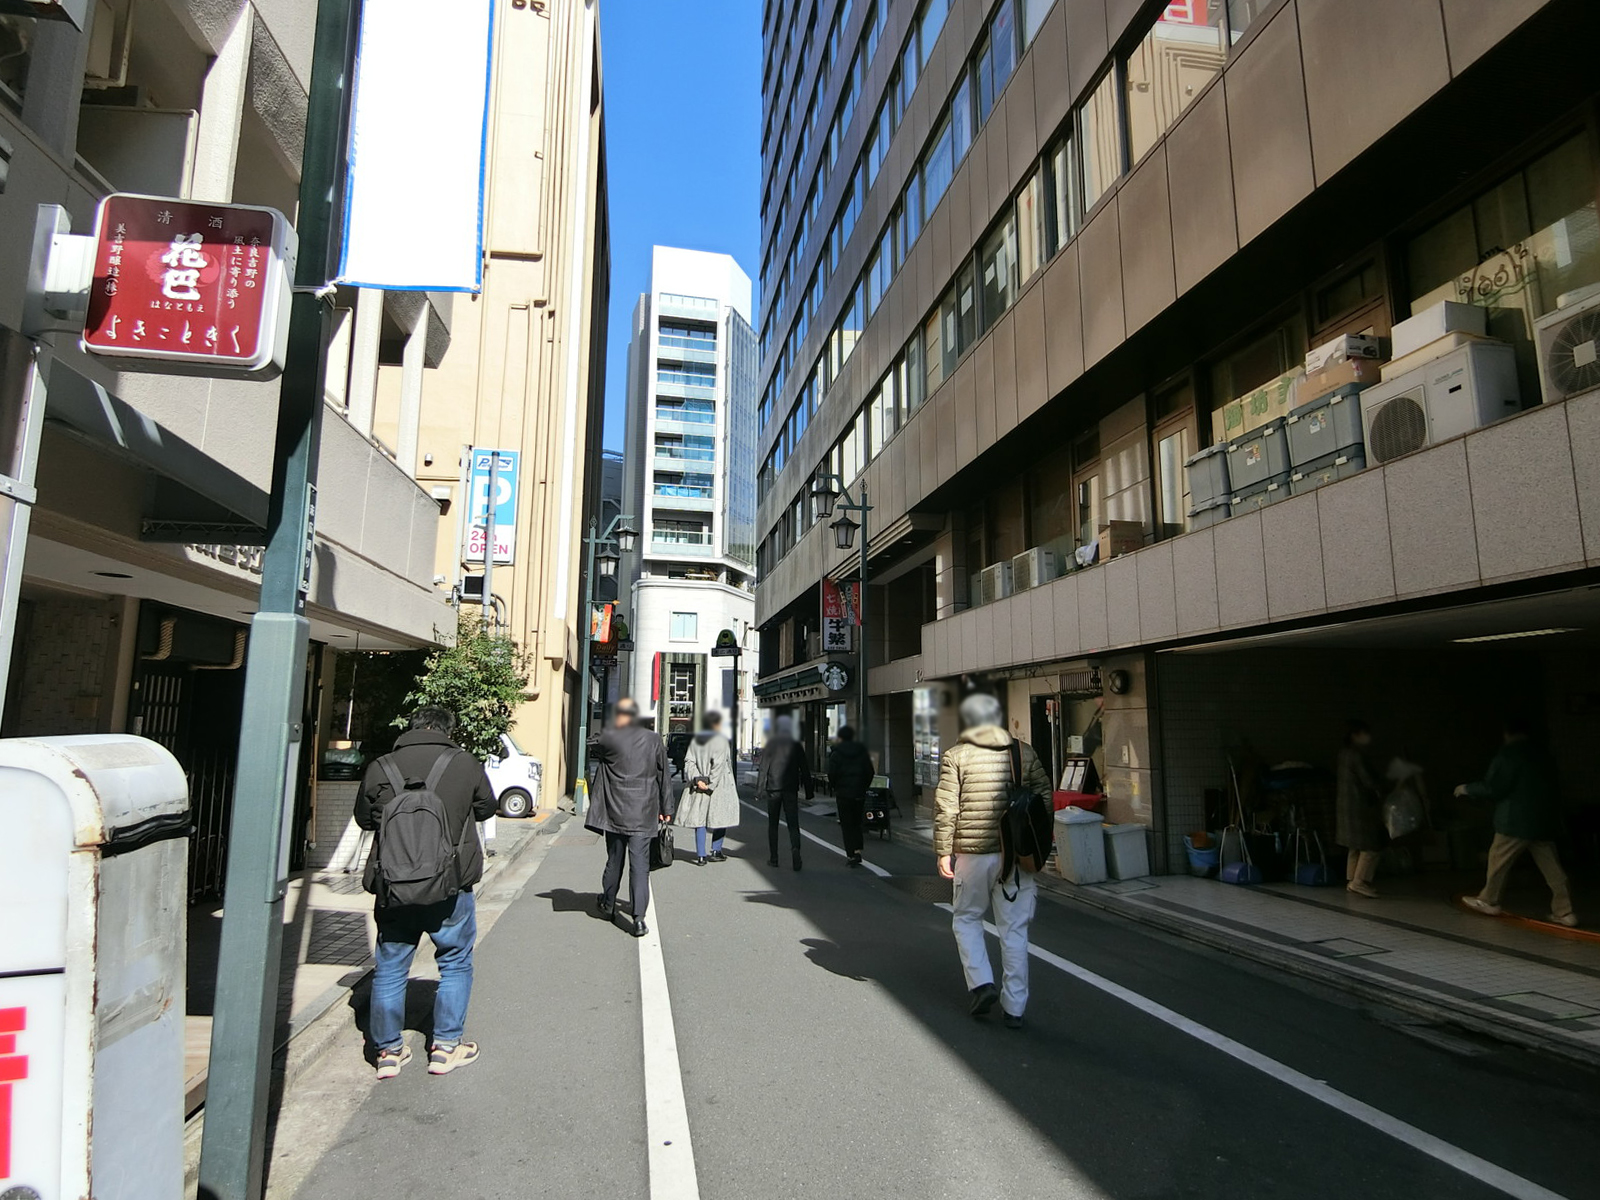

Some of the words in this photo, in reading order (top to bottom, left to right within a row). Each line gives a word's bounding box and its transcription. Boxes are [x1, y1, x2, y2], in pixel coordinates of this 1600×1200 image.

[156, 210, 224, 229] 清酒
[161, 232, 208, 301] 花巴
[244, 236, 262, 289] 奈良吉野の
[150, 300, 205, 313] はなともえ
[106, 314, 241, 355] よきこときく
[469, 543, 508, 555] OPEN
